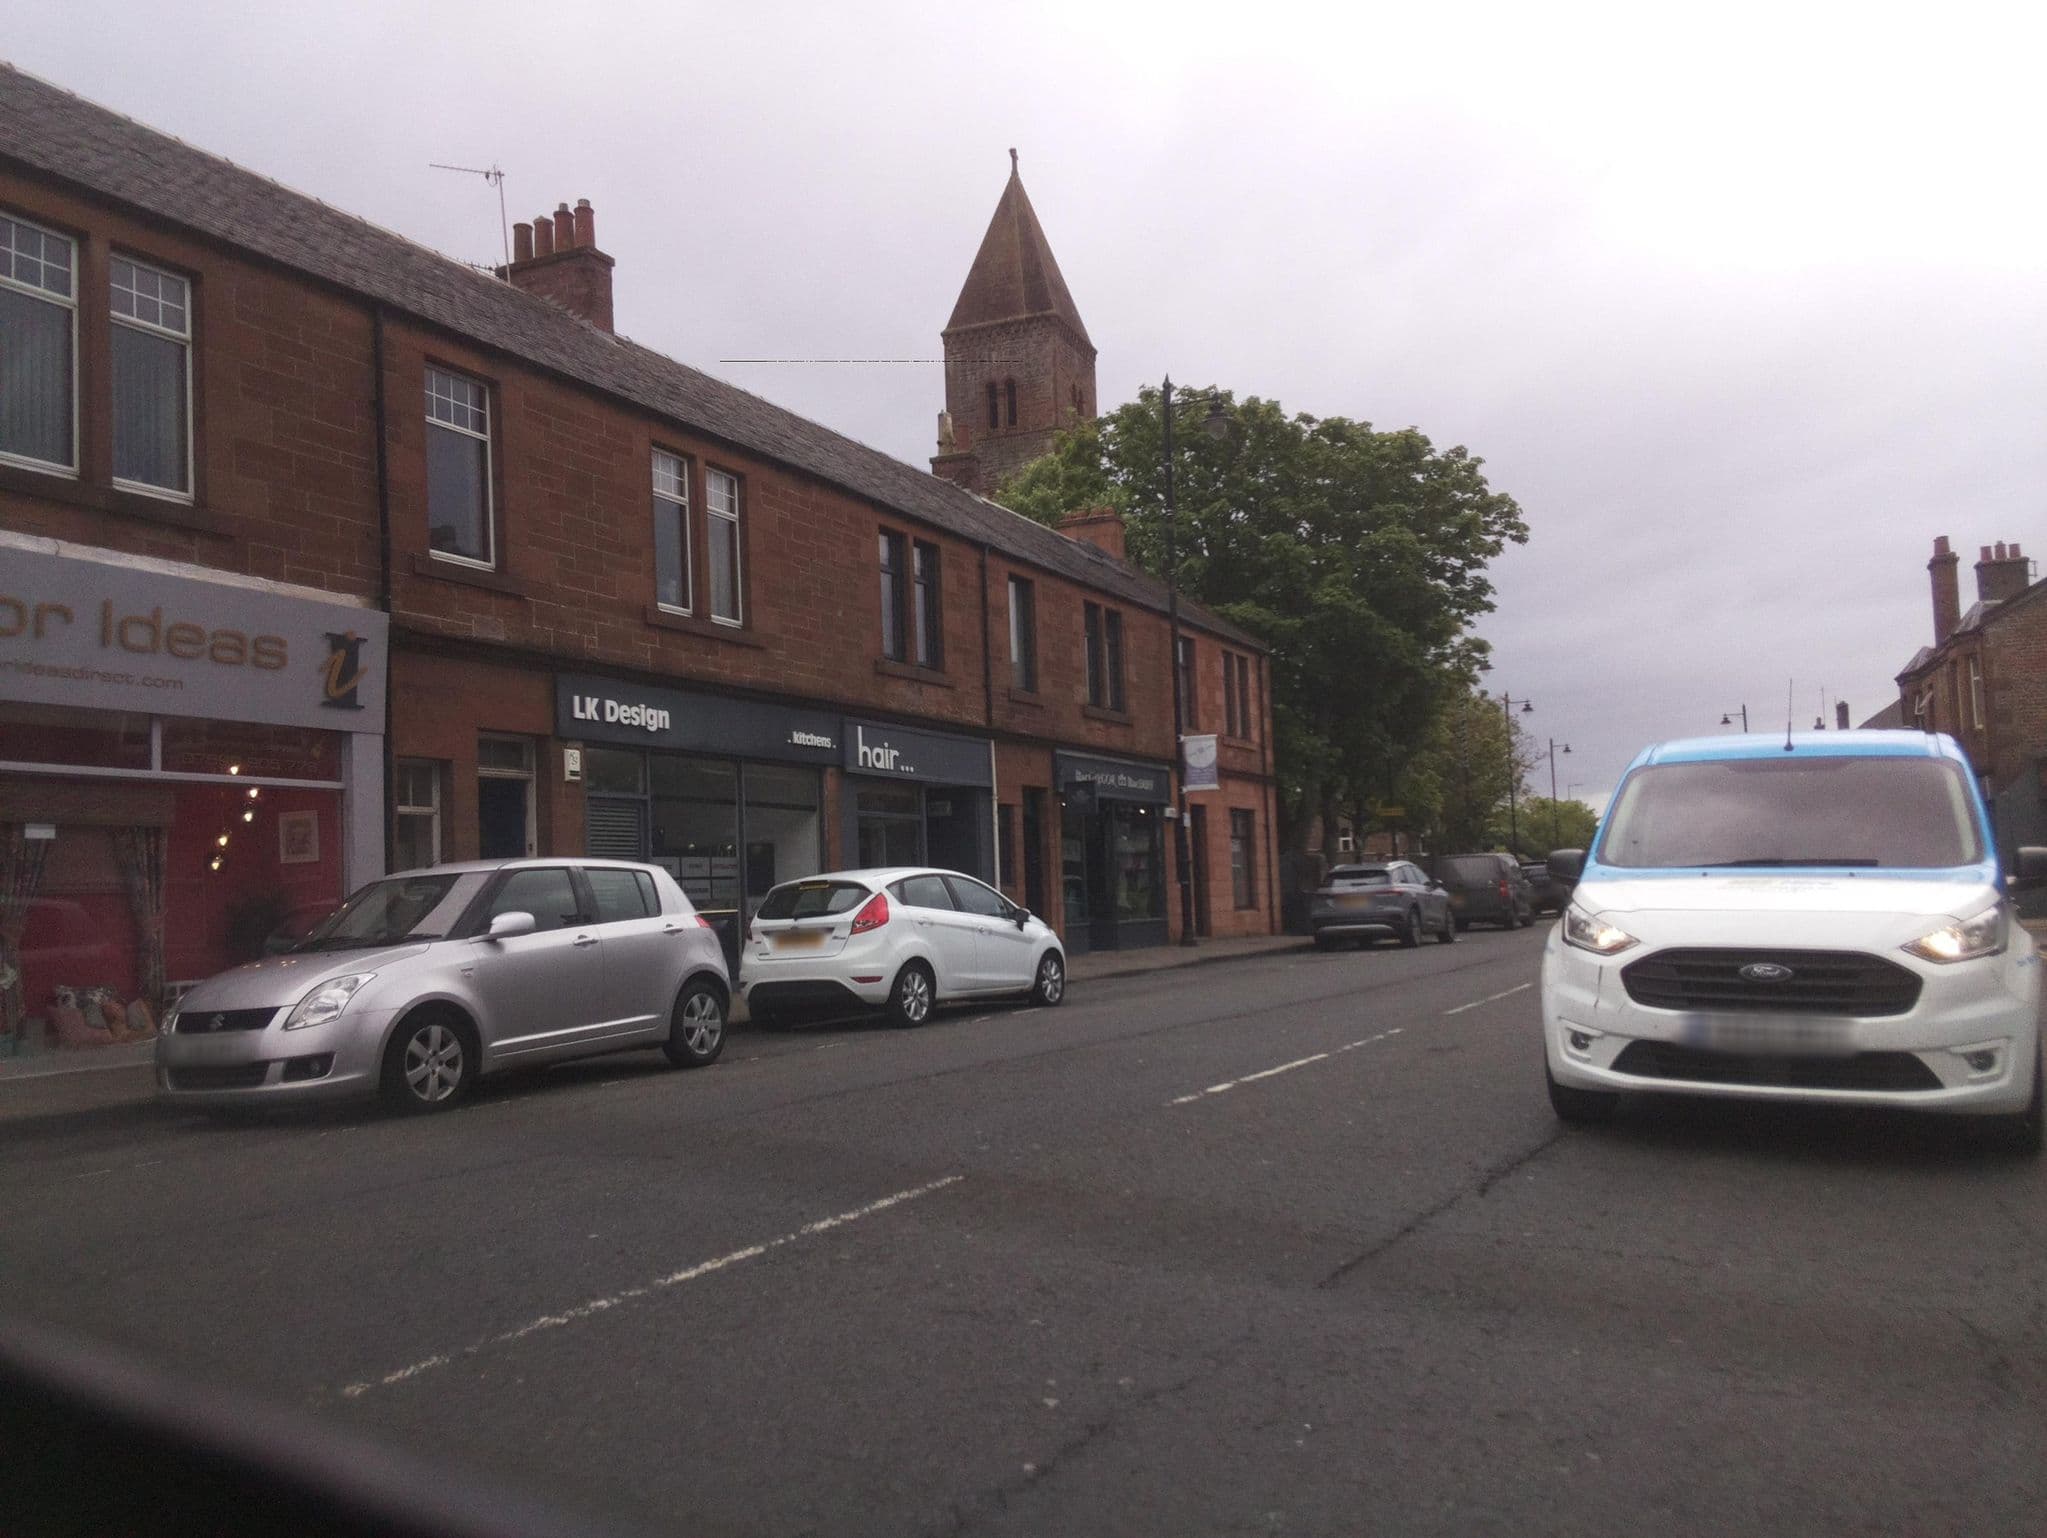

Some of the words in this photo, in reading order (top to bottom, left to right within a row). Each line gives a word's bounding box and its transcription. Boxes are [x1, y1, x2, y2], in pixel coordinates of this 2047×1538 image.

[102, 597, 289, 671] Ideas
[573, 695, 600, 722] LK
[604, 699, 671, 732] Design
[792, 731, 832, 749] kitchens
